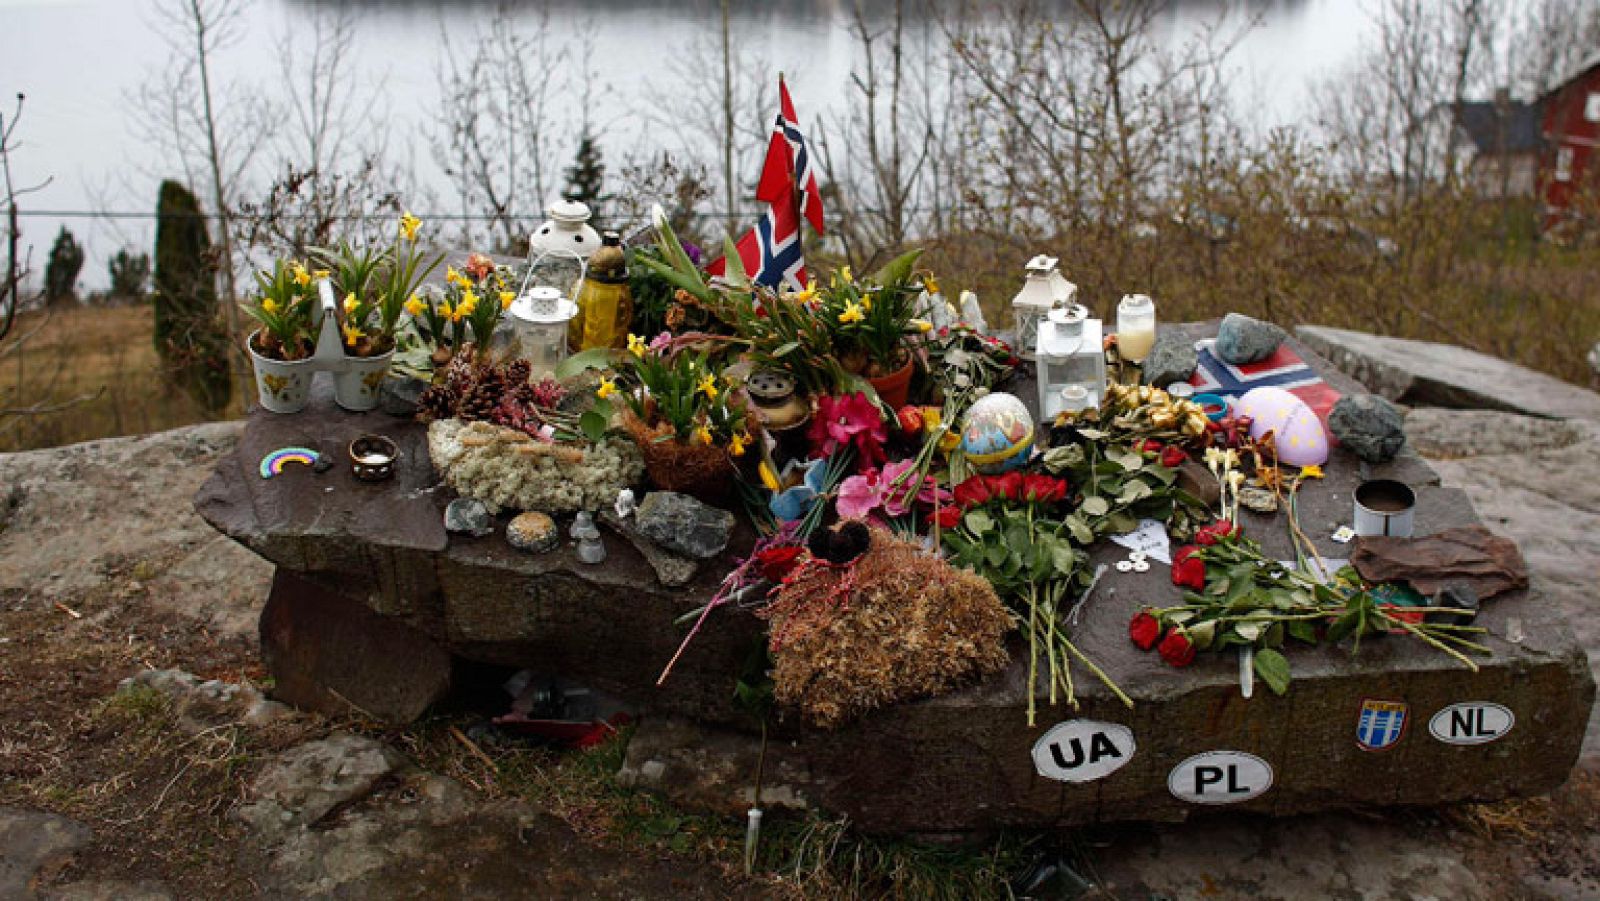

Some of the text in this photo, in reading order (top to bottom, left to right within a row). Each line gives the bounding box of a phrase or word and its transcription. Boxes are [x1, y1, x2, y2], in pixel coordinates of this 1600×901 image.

[1450, 709, 1496, 737] NL
[1050, 732, 1121, 769] UA
[1195, 765, 1250, 795] PL
